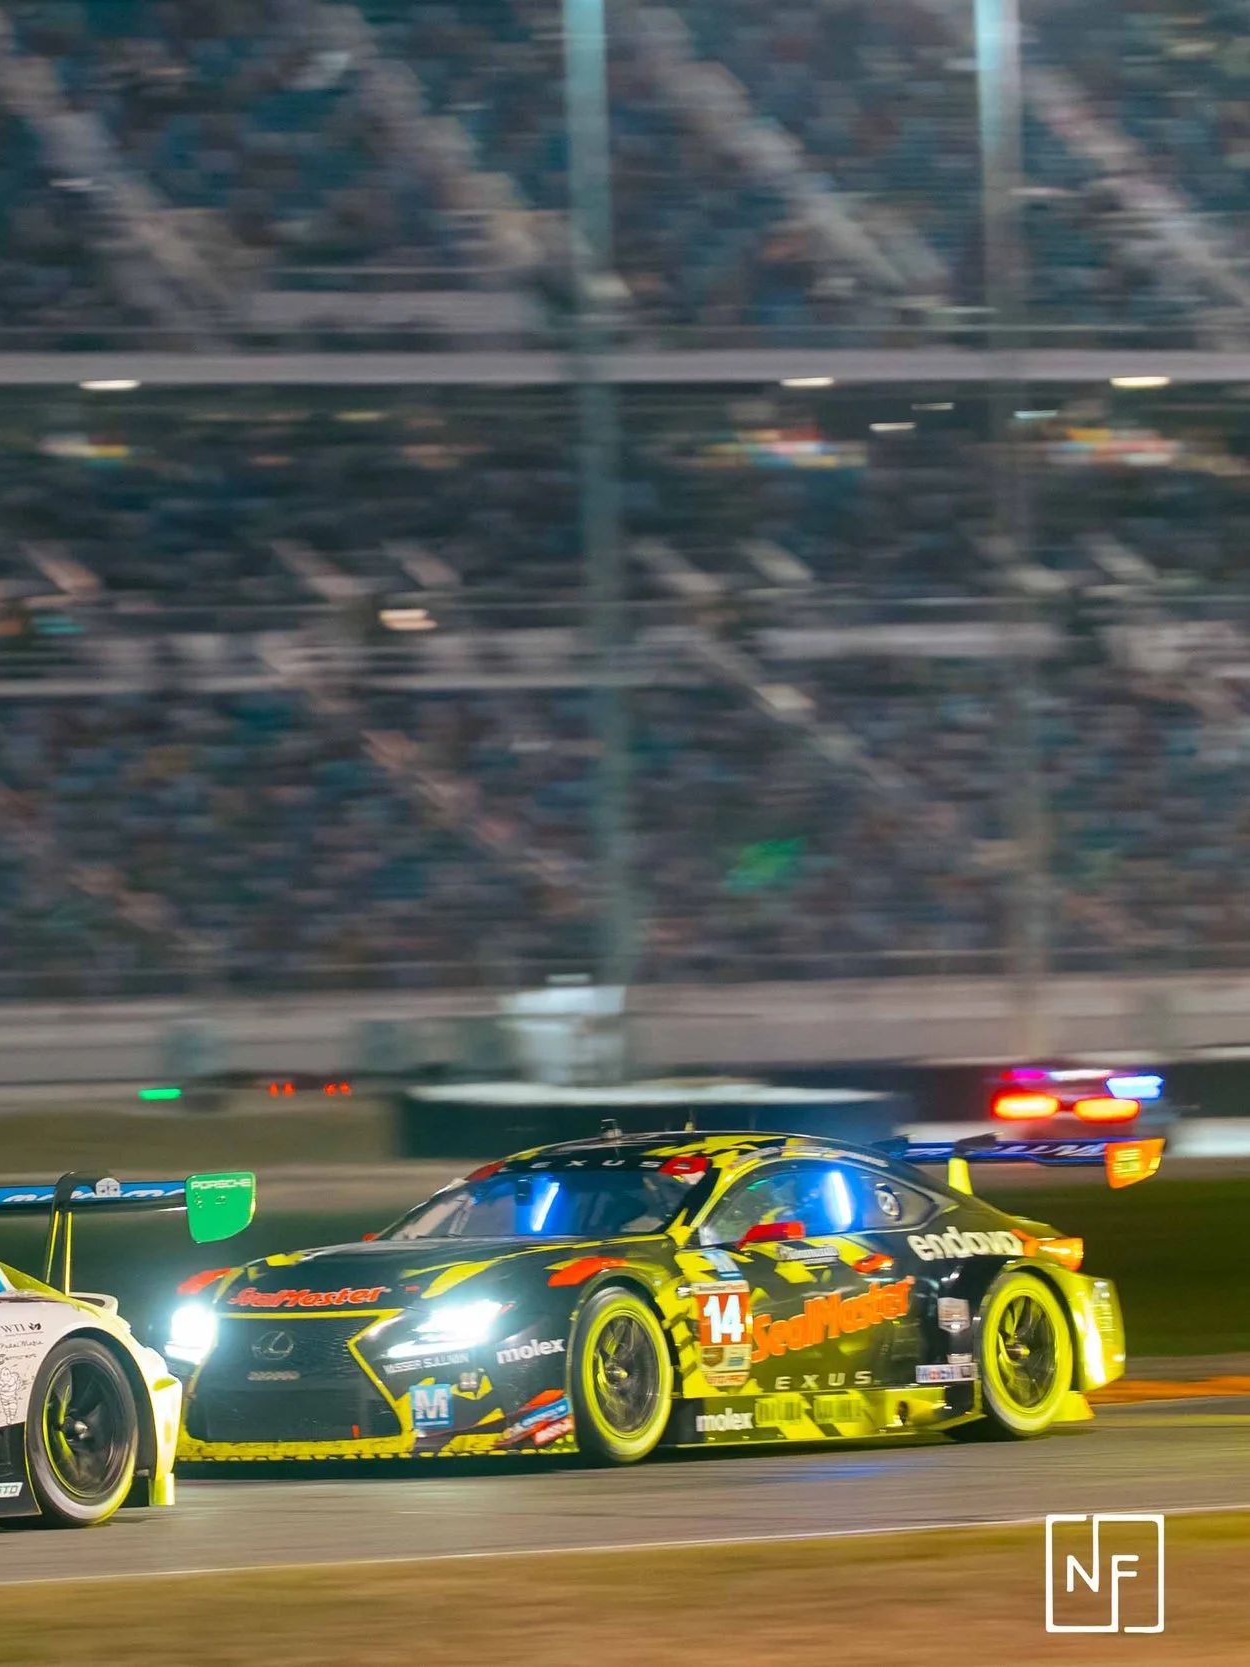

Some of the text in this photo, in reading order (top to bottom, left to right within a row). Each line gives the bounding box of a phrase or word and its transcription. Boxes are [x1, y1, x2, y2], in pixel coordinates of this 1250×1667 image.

[190, 1179, 251, 1190] PORSCHE
[703, 1294, 745, 1344] 14
[751, 1276, 916, 1364] SealMaster
[496, 1338, 567, 1364] molex
[414, 1389, 450, 1420] M
[695, 1407, 754, 1432] molex
